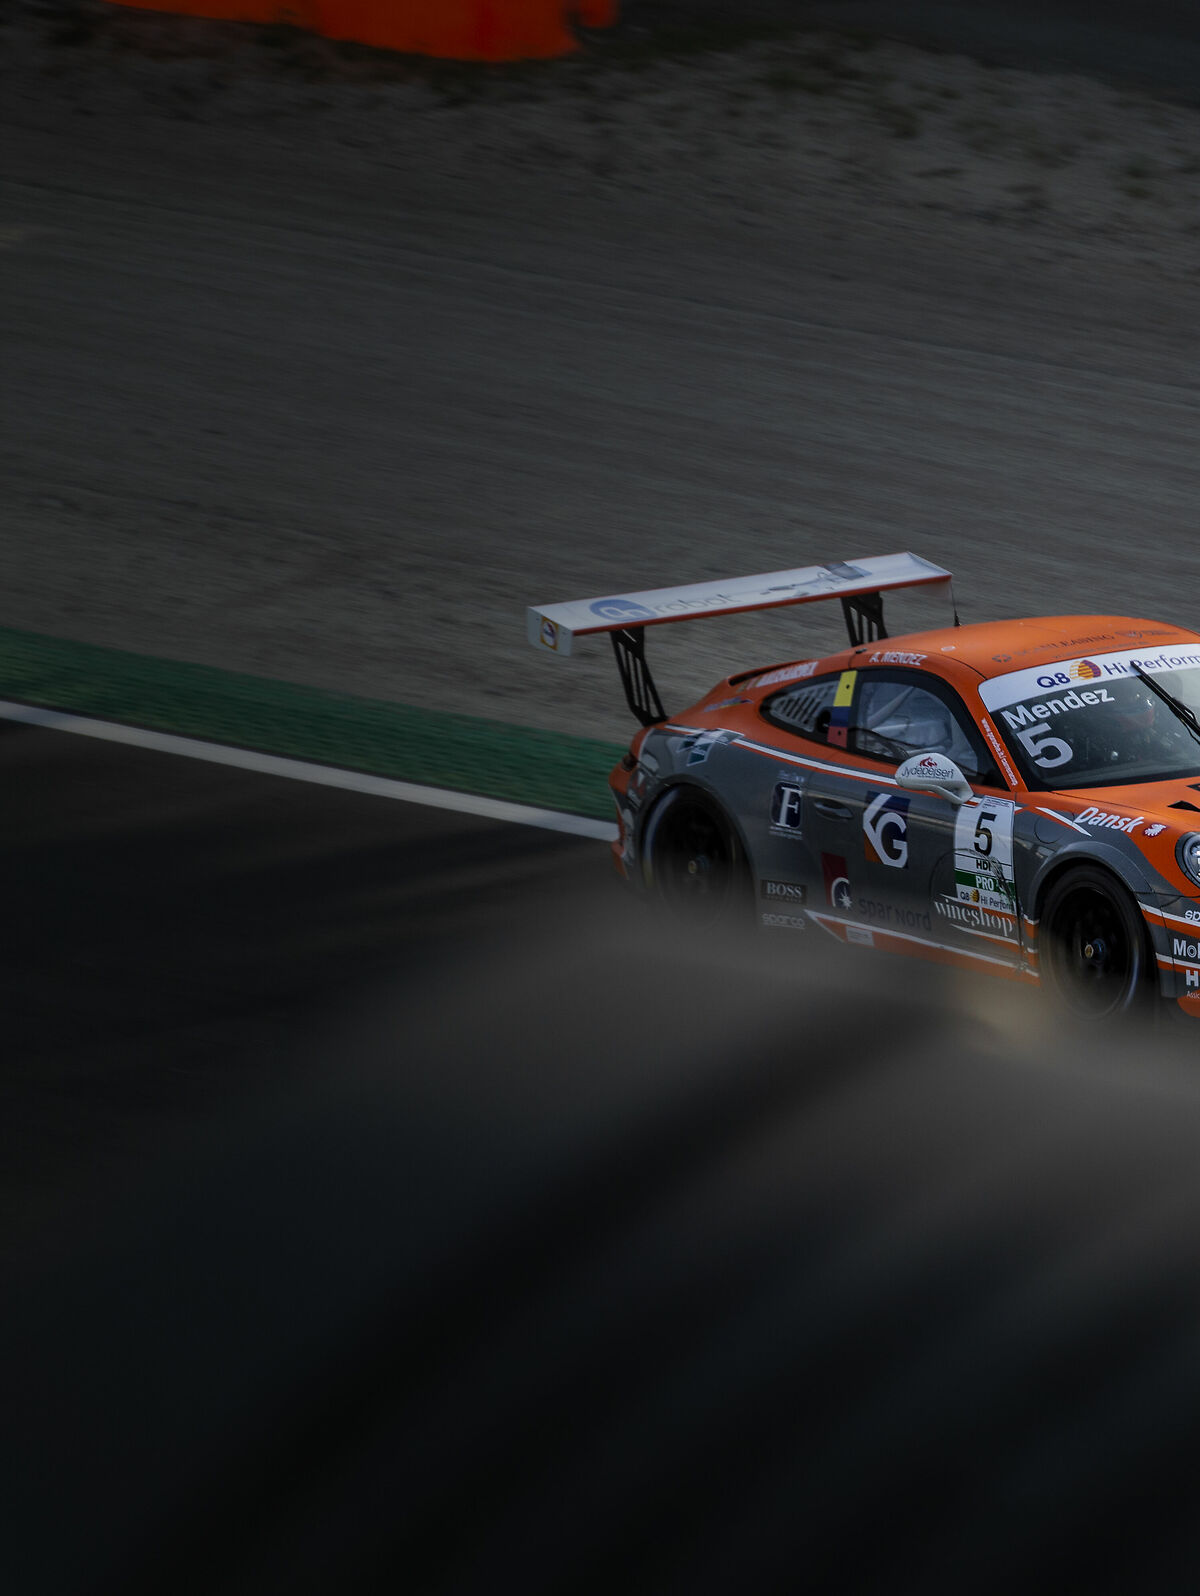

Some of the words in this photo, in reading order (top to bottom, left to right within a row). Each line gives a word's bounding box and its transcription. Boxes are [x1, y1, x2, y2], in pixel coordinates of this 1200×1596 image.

[881, 651, 928, 666] MENDEZ
[1037, 672, 1071, 689] Q8
[1103, 661, 1127, 675] Hi
[1000, 688, 1115, 729] Mendez
[1016, 722, 1073, 769] 5
[1074, 806, 1144, 833] Dansk
[973, 811, 997, 856] 5
[976, 860, 991, 871] HDI
[767, 882, 802, 898] BOSS
[975, 875, 995, 891] PRO
[960, 891, 969, 901] Q8
